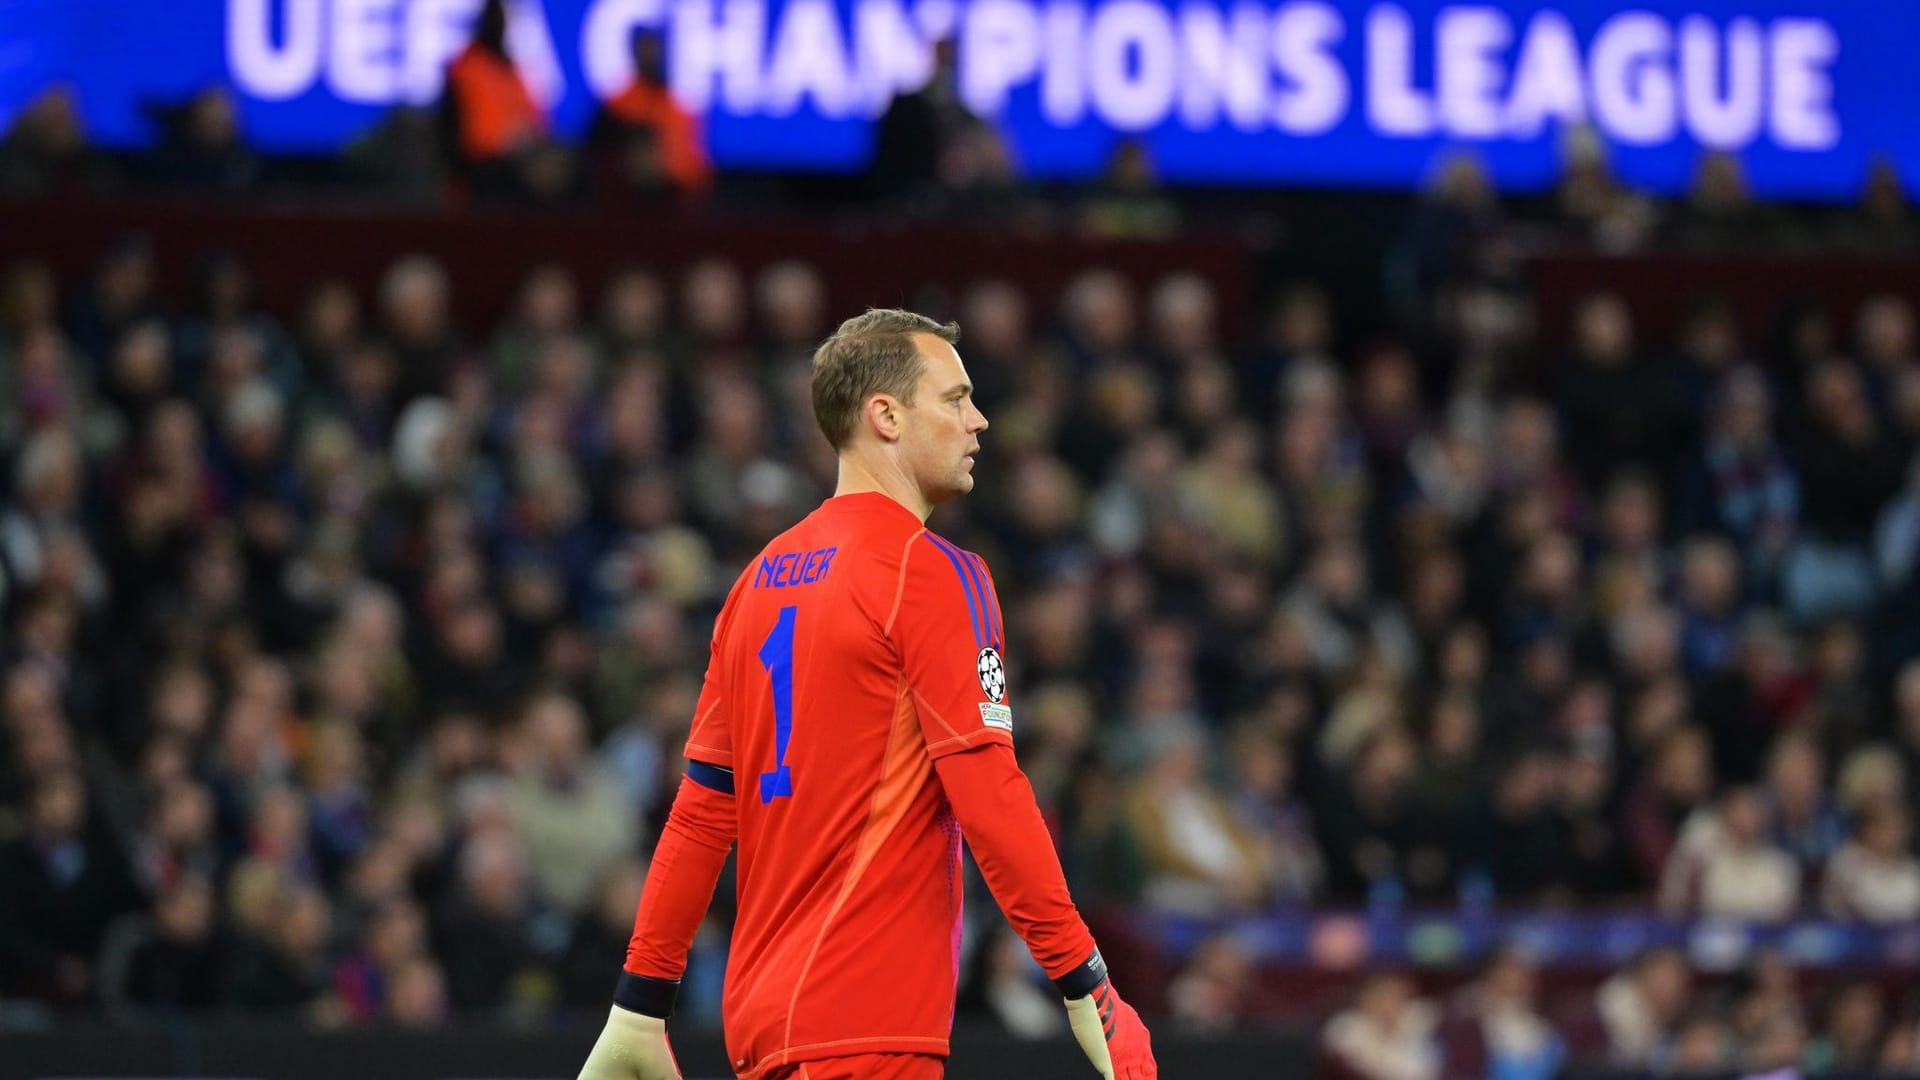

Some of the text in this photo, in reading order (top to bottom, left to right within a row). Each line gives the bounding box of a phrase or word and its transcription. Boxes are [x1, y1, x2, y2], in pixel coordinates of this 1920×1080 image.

[582, 0, 1348, 134] CHAMPIONS
[1367, 4, 1836, 150] LEAGUE
[754, 547, 837, 588] NEUER
[758, 605, 798, 804] 1
